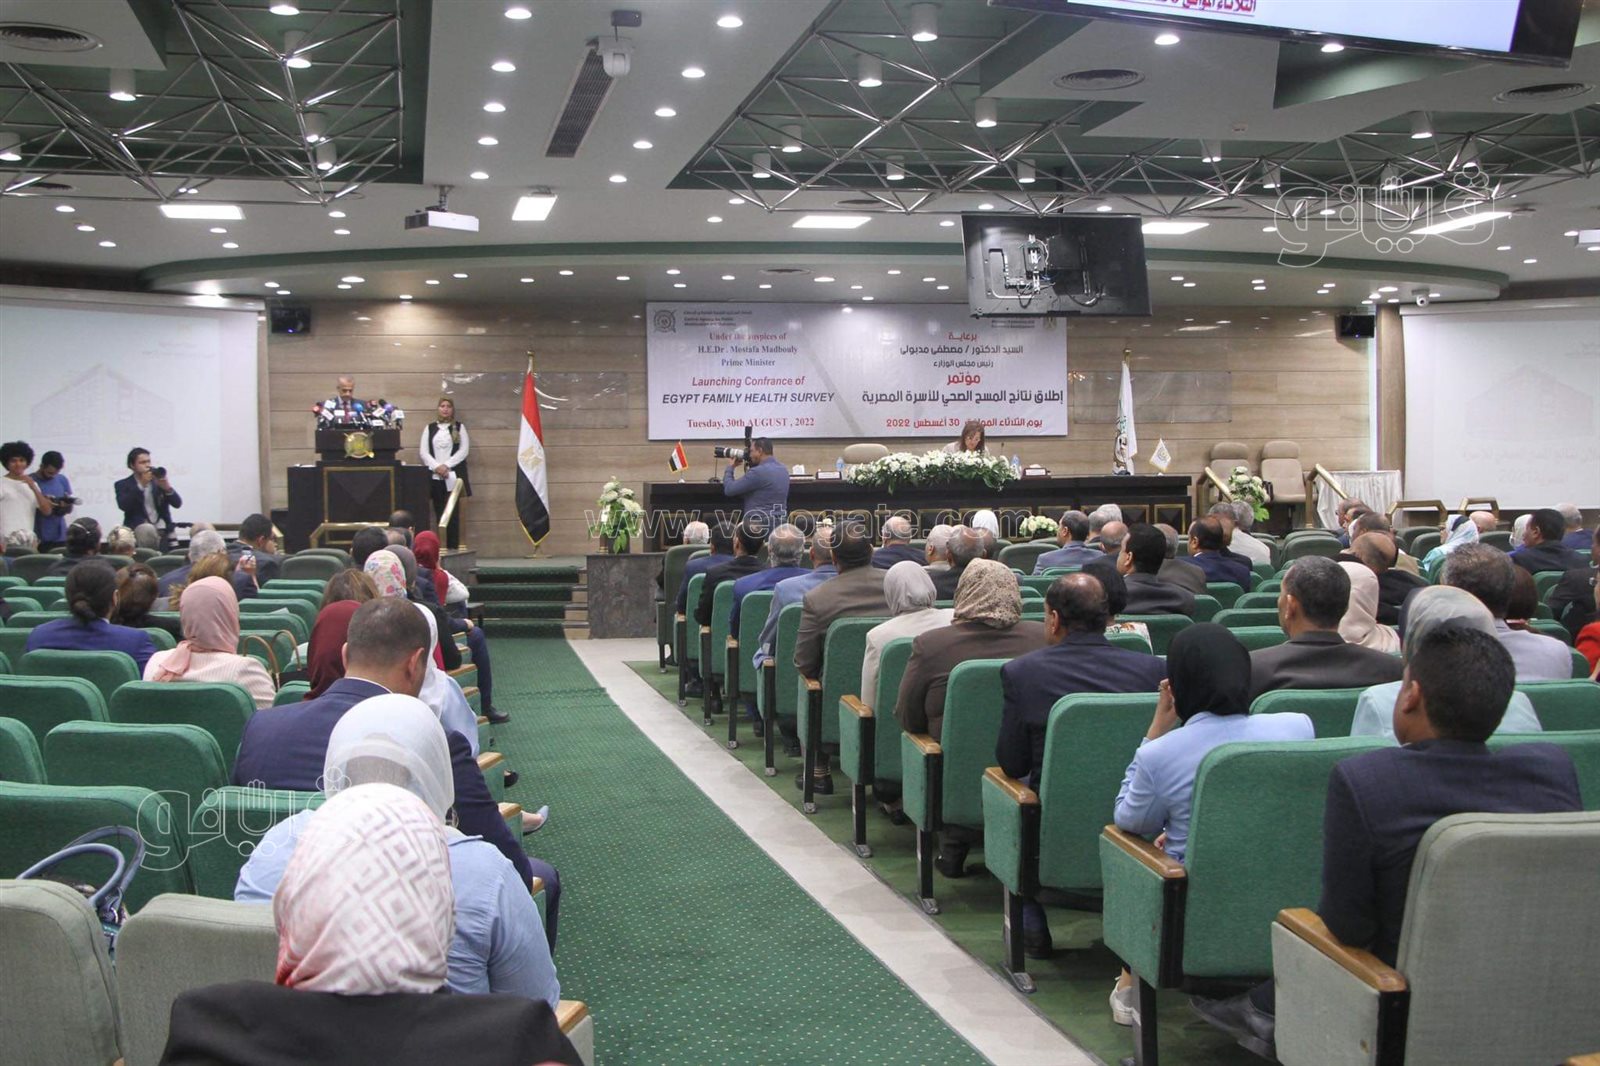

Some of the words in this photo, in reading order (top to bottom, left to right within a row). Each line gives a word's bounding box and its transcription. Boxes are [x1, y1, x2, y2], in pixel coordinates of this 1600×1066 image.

[731, 345, 759, 353] Mostafa
[972, 346, 1000, 355] الدكتور
[1003, 345, 1023, 354] السيد
[692, 377, 742, 388] Launching
[745, 377, 792, 386] Confrance
[795, 376, 805, 385] of
[947, 372, 980, 385] مؤتمر
[662, 394, 700, 403] EGYPT
[702, 394, 742, 403] FAMILY
[744, 393, 787, 402] HEALTH
[790, 392, 834, 402] SURVEY
[862, 391, 903, 404] المصرية
[906, 391, 939, 404] للأسرة
[942, 390, 973, 406] الصحي
[975, 390, 1006, 404] المسح
[1009, 391, 1032, 404] نتائج
[1035, 391, 1063, 404] إطلاق
[687, 419, 725, 429] Tuesday,
[746, 418, 787, 426] AUGUST
[795, 418, 814, 426] 2022
[914, 418, 947, 428] أغسطس
[1000, 417, 1025, 426] الثلاثاء
[1027, 419, 1042, 428] يوم
